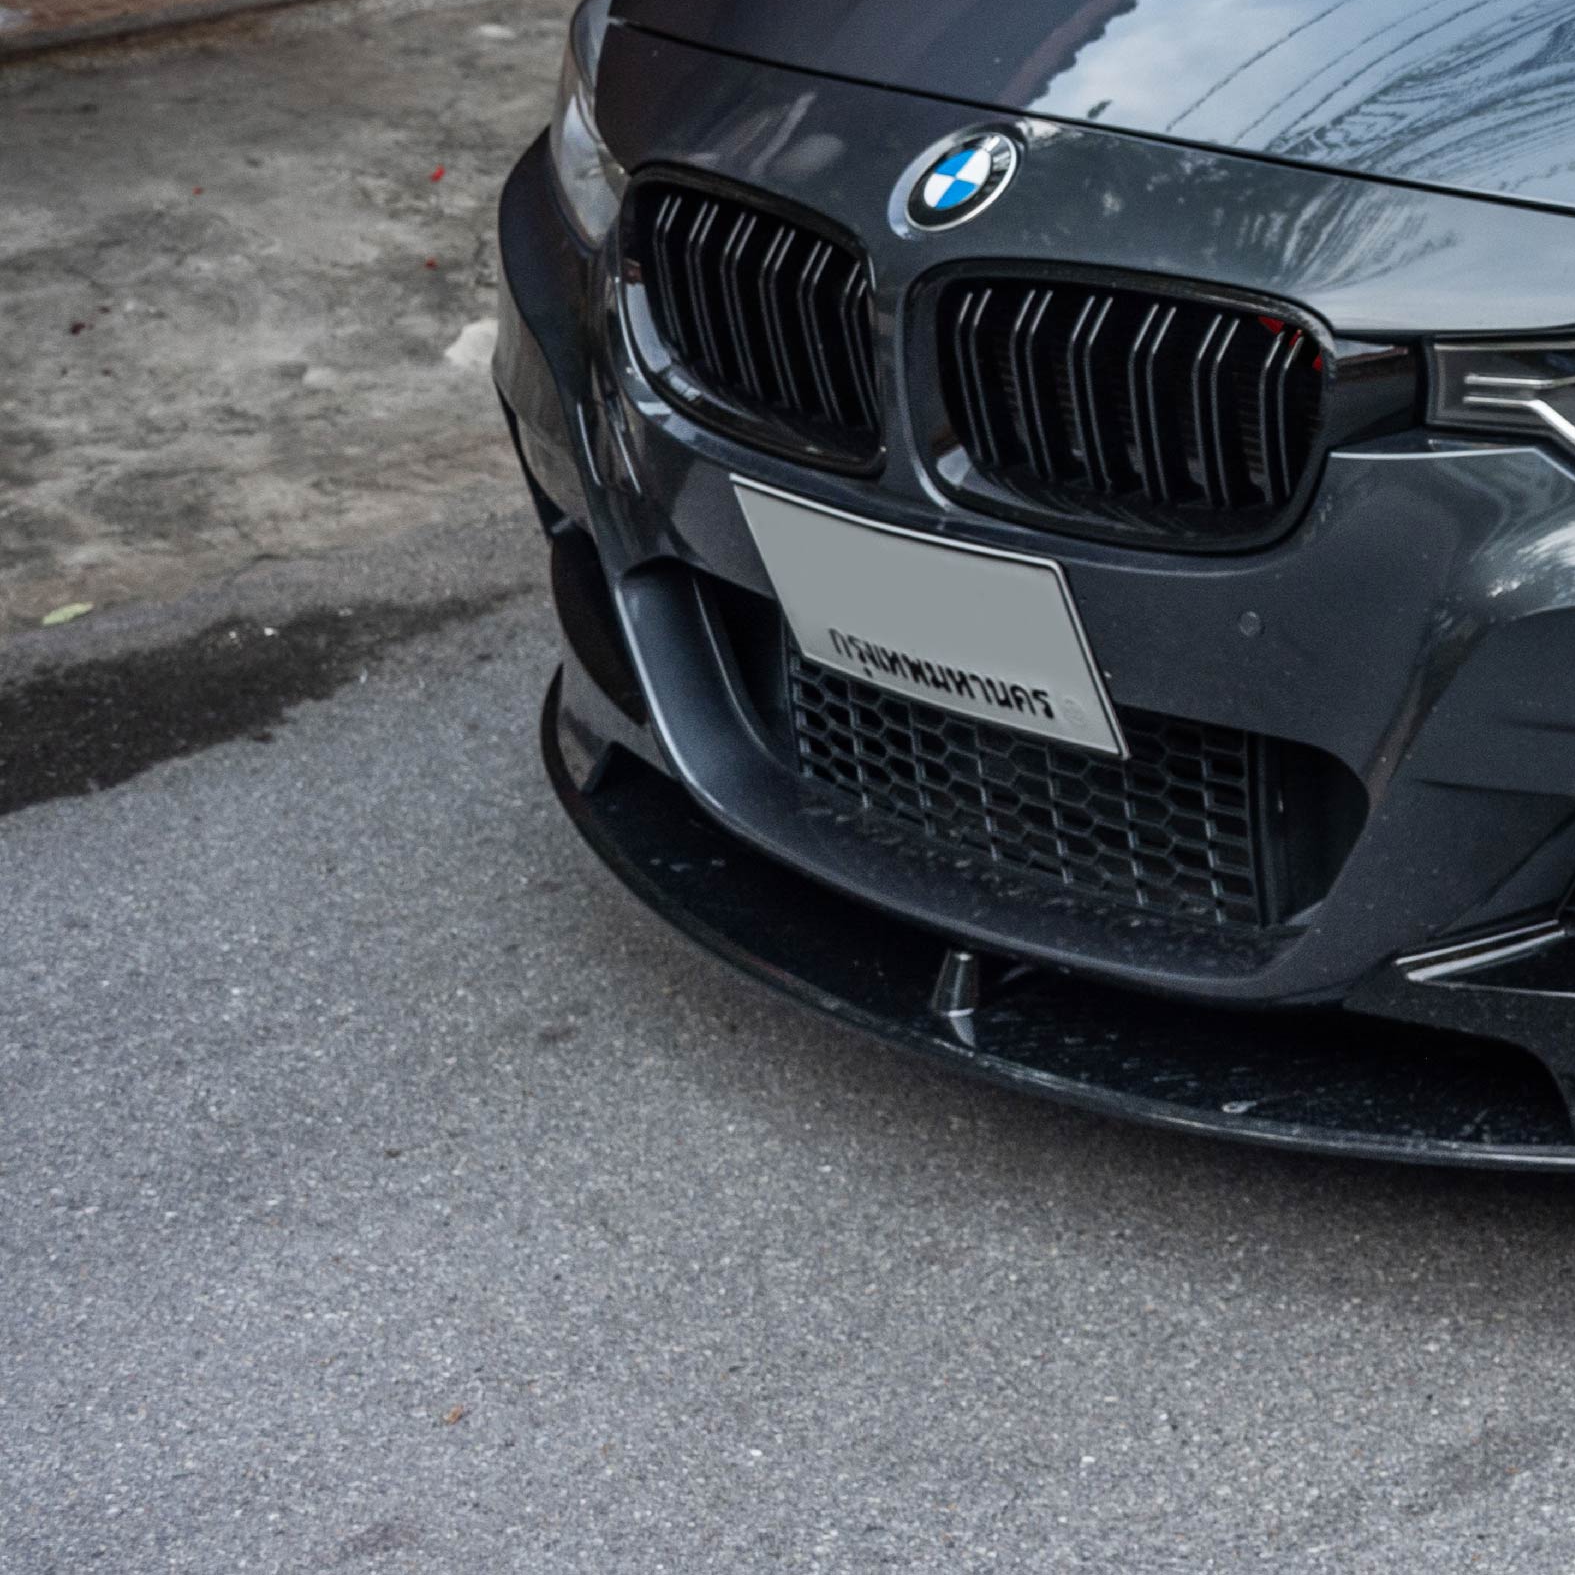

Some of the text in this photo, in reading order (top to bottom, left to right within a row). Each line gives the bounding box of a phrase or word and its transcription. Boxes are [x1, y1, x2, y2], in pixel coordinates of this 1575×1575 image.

[828, 628, 1054, 719] กรุงเทพมหานคร
